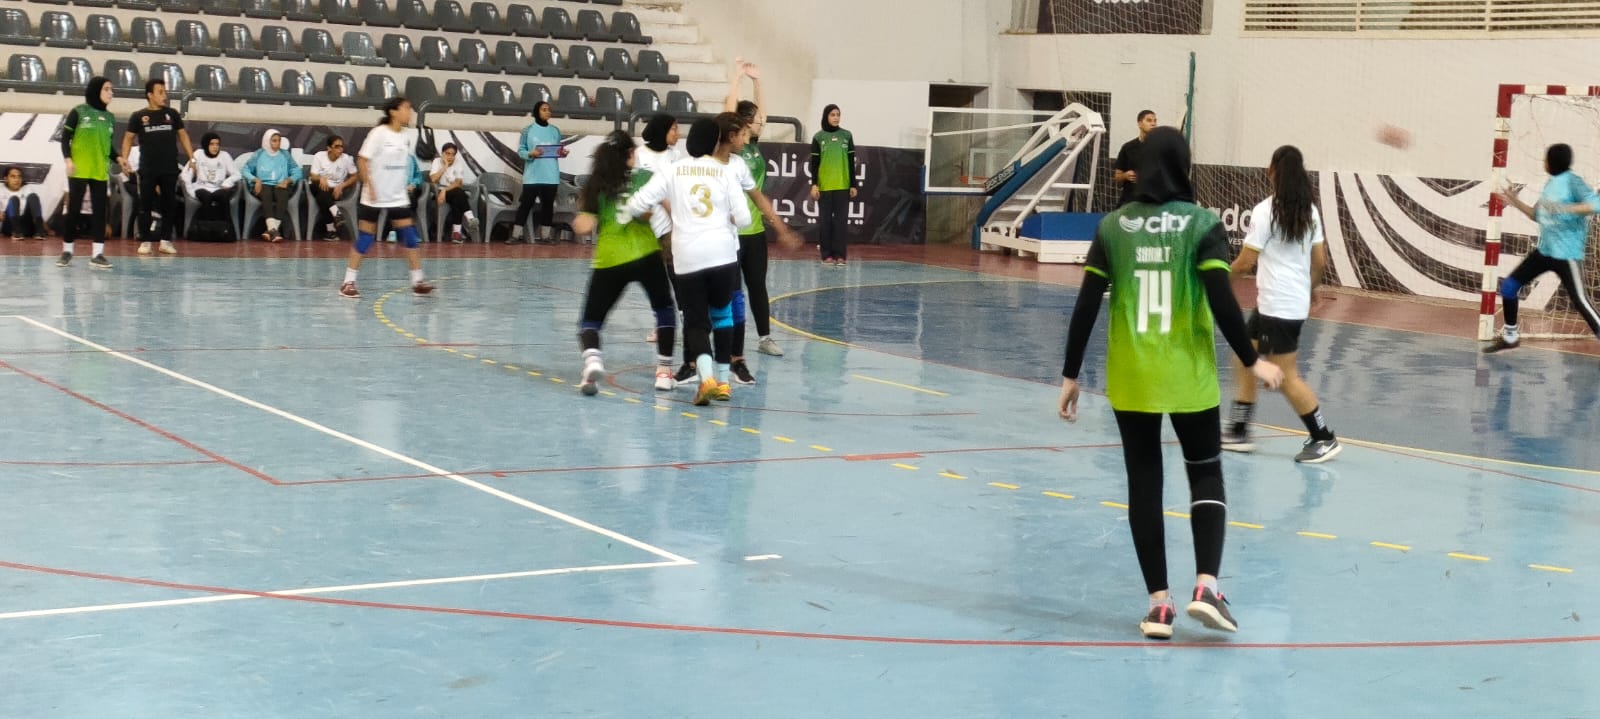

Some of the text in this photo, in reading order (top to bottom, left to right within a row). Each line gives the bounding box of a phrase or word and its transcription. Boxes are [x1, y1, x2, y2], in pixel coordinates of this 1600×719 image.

[690, 184, 714, 218] 3
[1144, 211, 1193, 234] city
[1134, 269, 1172, 334] 14
